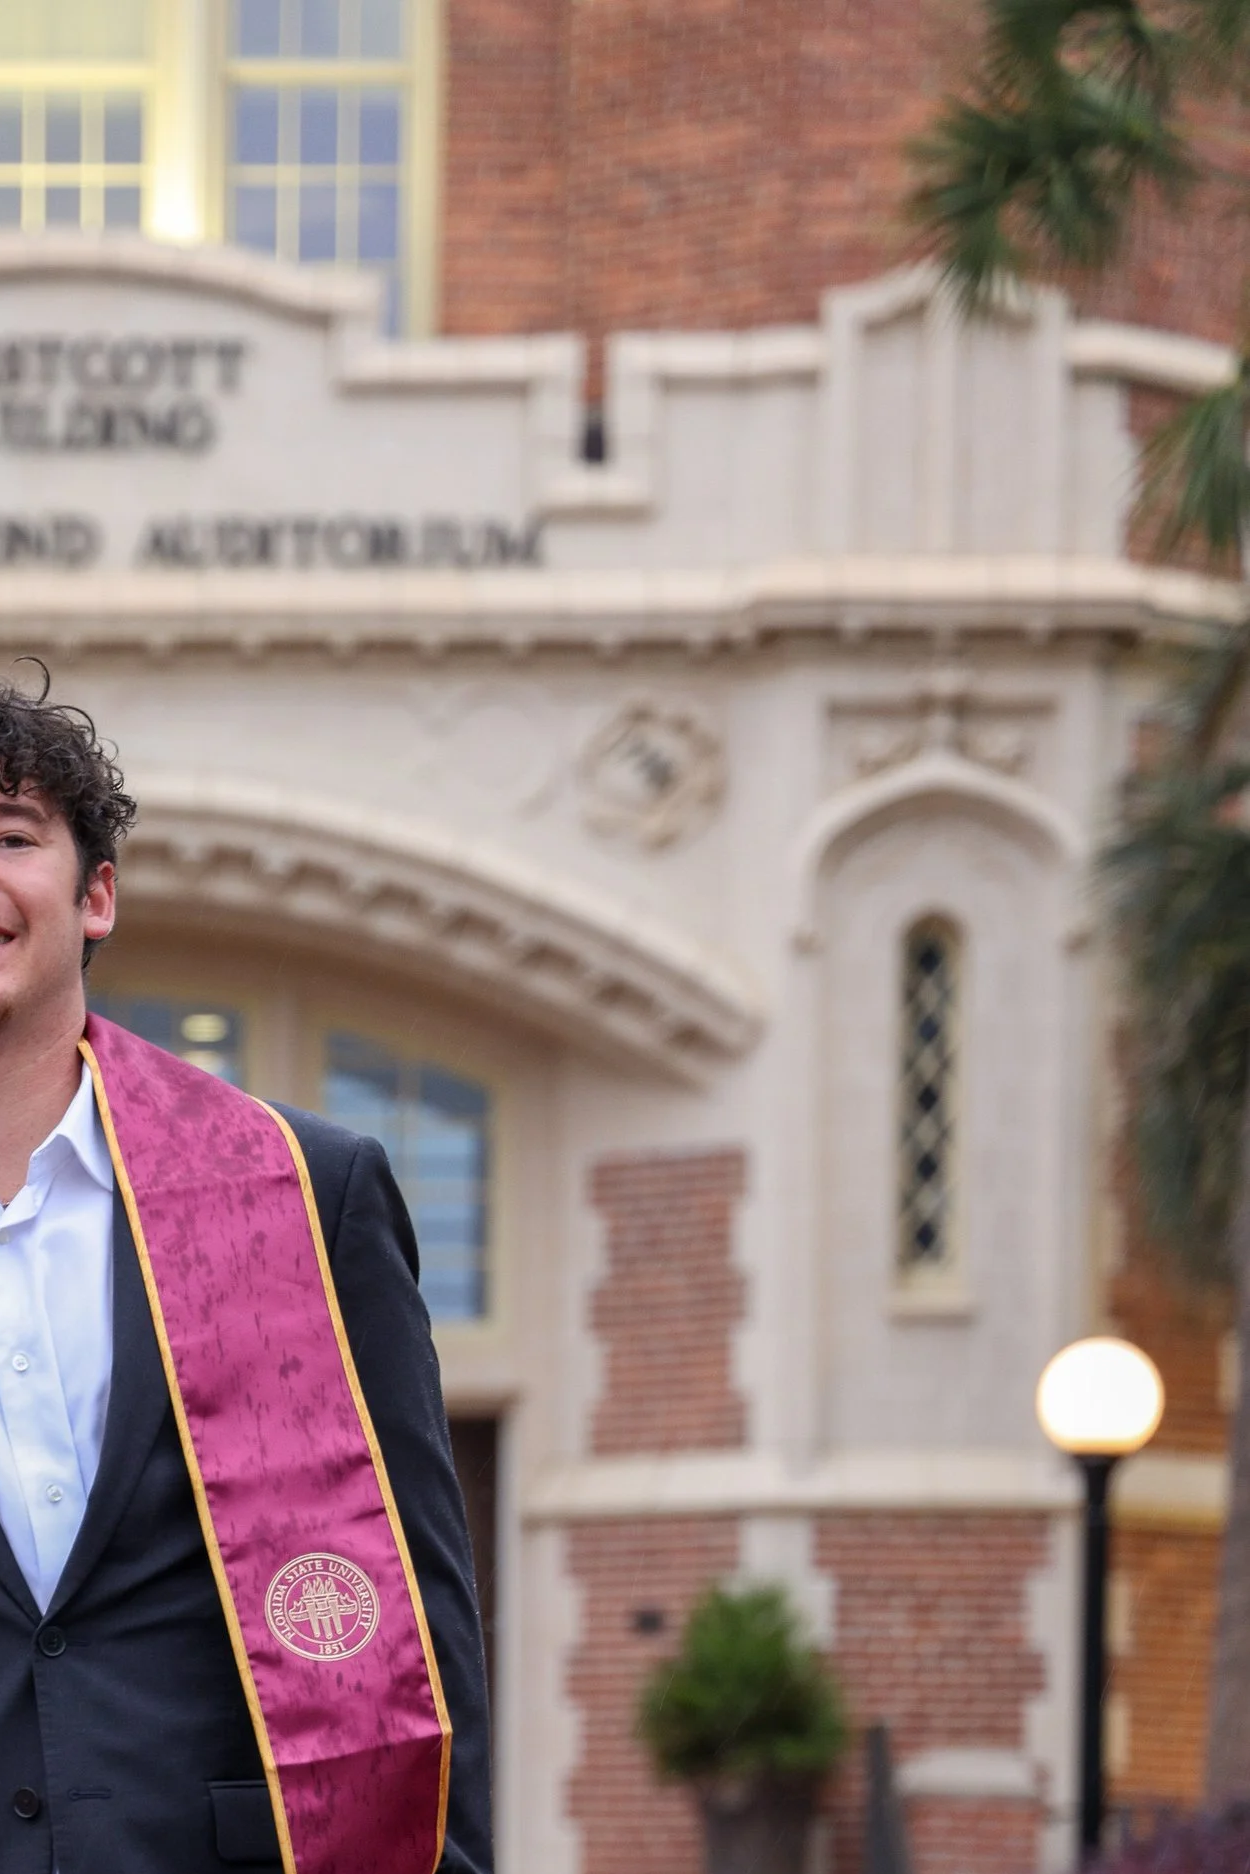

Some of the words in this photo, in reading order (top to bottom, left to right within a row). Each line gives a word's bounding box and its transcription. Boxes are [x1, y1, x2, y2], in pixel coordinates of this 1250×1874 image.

[136, 513, 546, 569] AUDITORIUM
[272, 1583, 296, 1640] FLORIDA
[285, 1559, 324, 1583] STATE
[328, 1561, 373, 1630] UNIVERSITY
[318, 1642, 347, 1655] 1851
